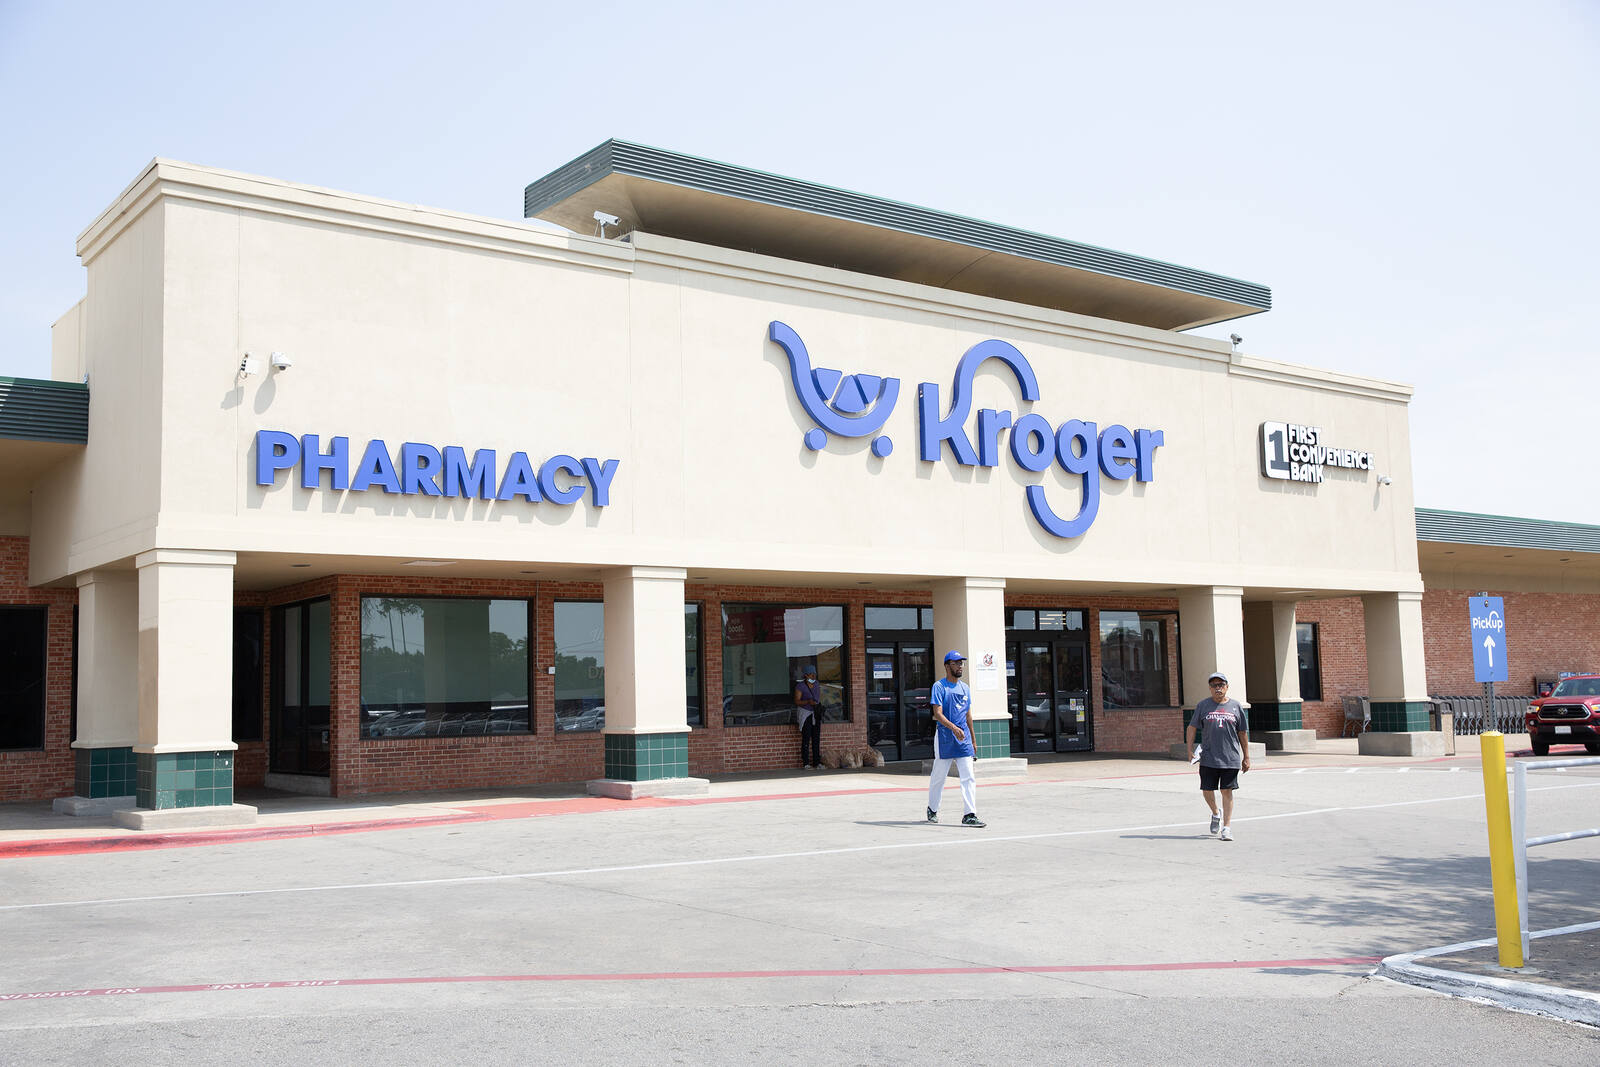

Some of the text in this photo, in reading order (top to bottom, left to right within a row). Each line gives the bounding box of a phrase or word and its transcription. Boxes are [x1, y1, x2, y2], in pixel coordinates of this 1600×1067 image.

[918, 339, 1164, 538] Kroger
[1269, 430, 1290, 470] 1
[1288, 424, 1321, 445] FIRST
[256, 430, 620, 507] PHARMACY
[1289, 443, 1375, 470] CONVENIENCE
[1290, 461, 1324, 483] BANK
